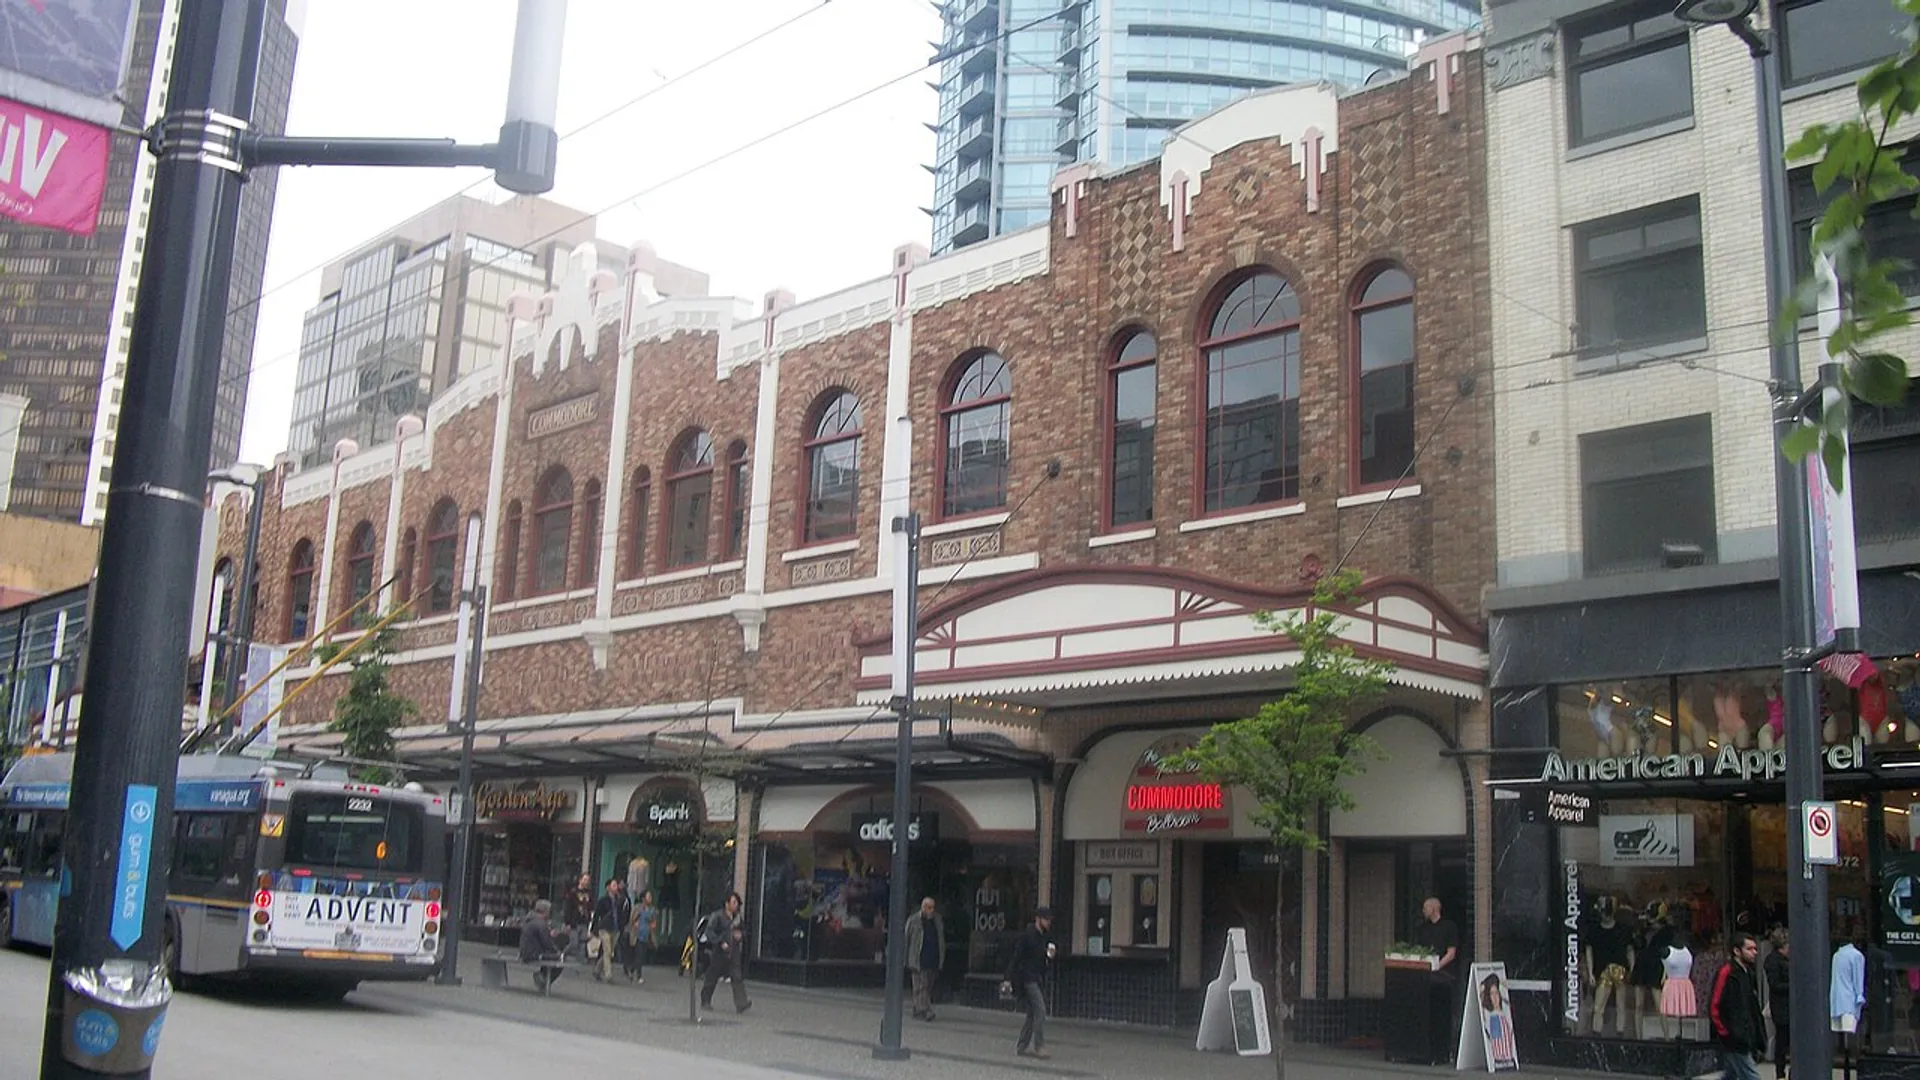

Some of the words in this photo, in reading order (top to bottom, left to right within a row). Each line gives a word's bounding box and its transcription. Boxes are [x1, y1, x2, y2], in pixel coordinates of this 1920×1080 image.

[1542, 749, 1704, 783] American
[1713, 735, 1864, 781] Appel
[1127, 784, 1223, 811] COMMODORE
[1548, 790, 1590, 808] American
[1548, 805, 1585, 822] Apparel
[859, 817, 921, 841] adis
[1564, 859, 1580, 929] Apparel
[306, 897, 412, 925] ADVENT
[1564, 933, 1579, 1022] American
